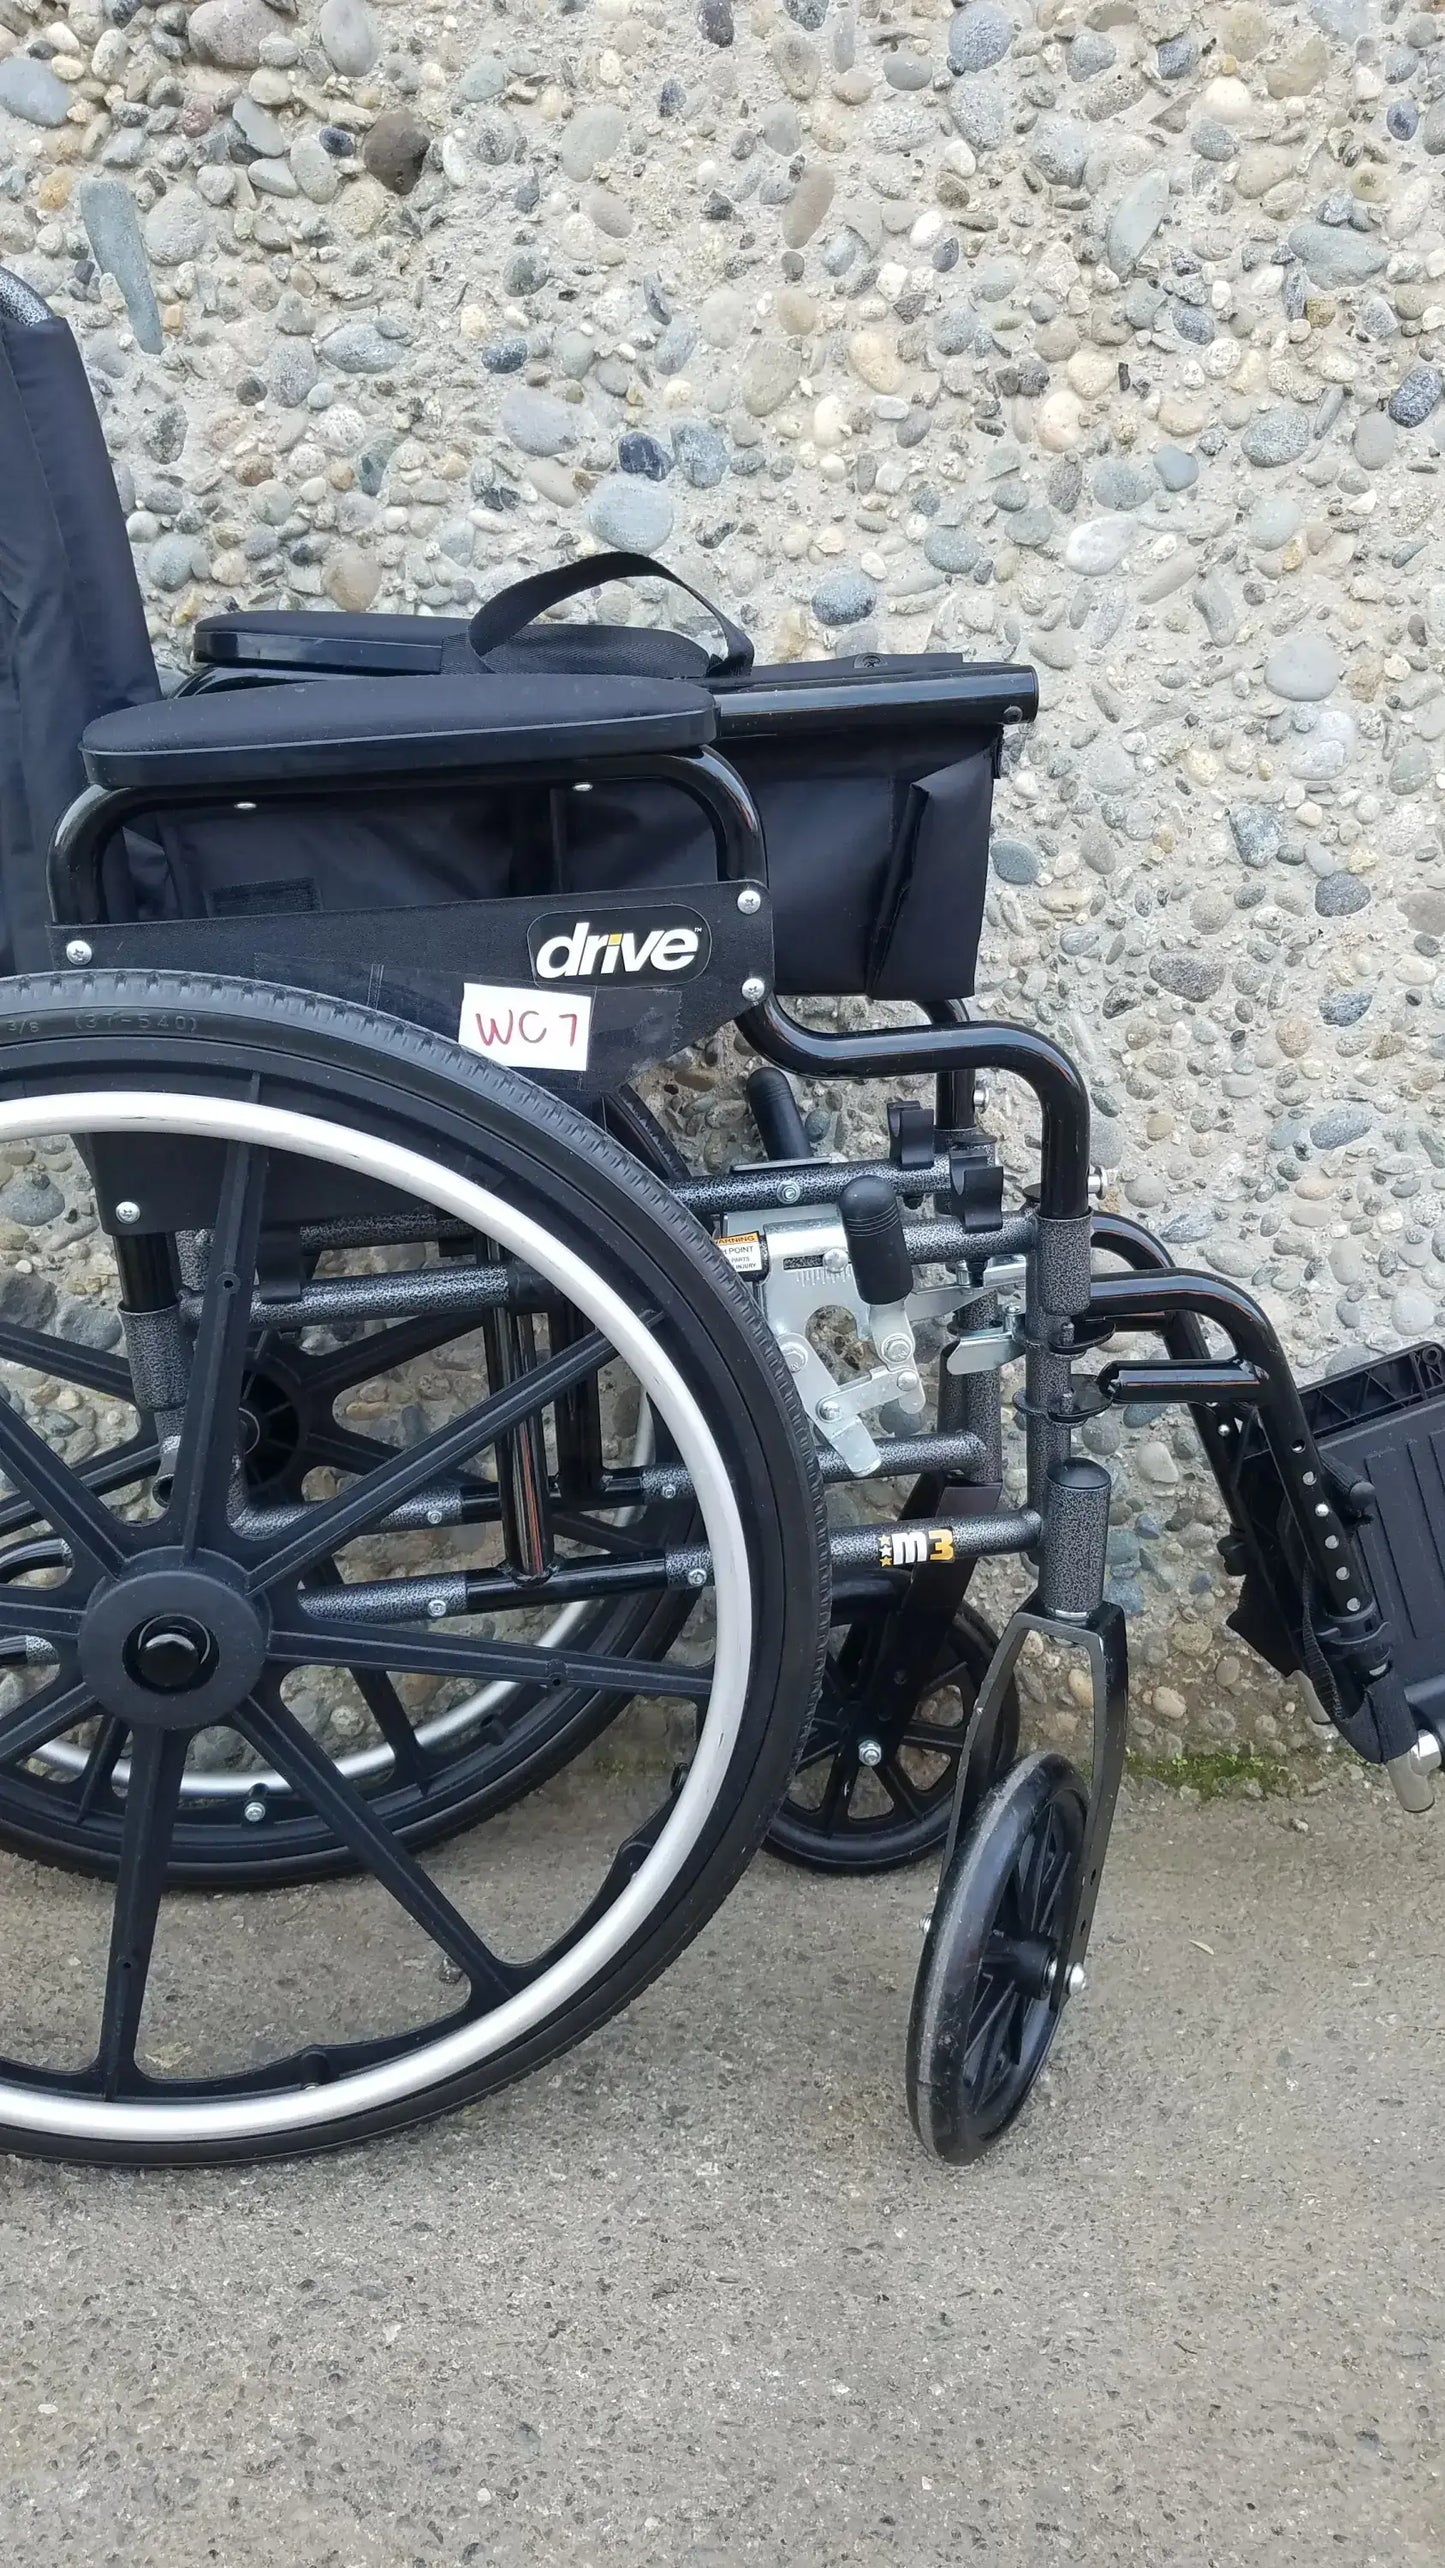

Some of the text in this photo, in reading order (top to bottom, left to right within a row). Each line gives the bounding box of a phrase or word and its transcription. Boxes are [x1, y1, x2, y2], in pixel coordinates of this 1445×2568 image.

[536, 922, 698, 979] drive
[74, 1013, 197, 1033] (37-540)
[475, 1009, 578, 1047] WC 7
[729, 1246, 753, 1254] POINT
